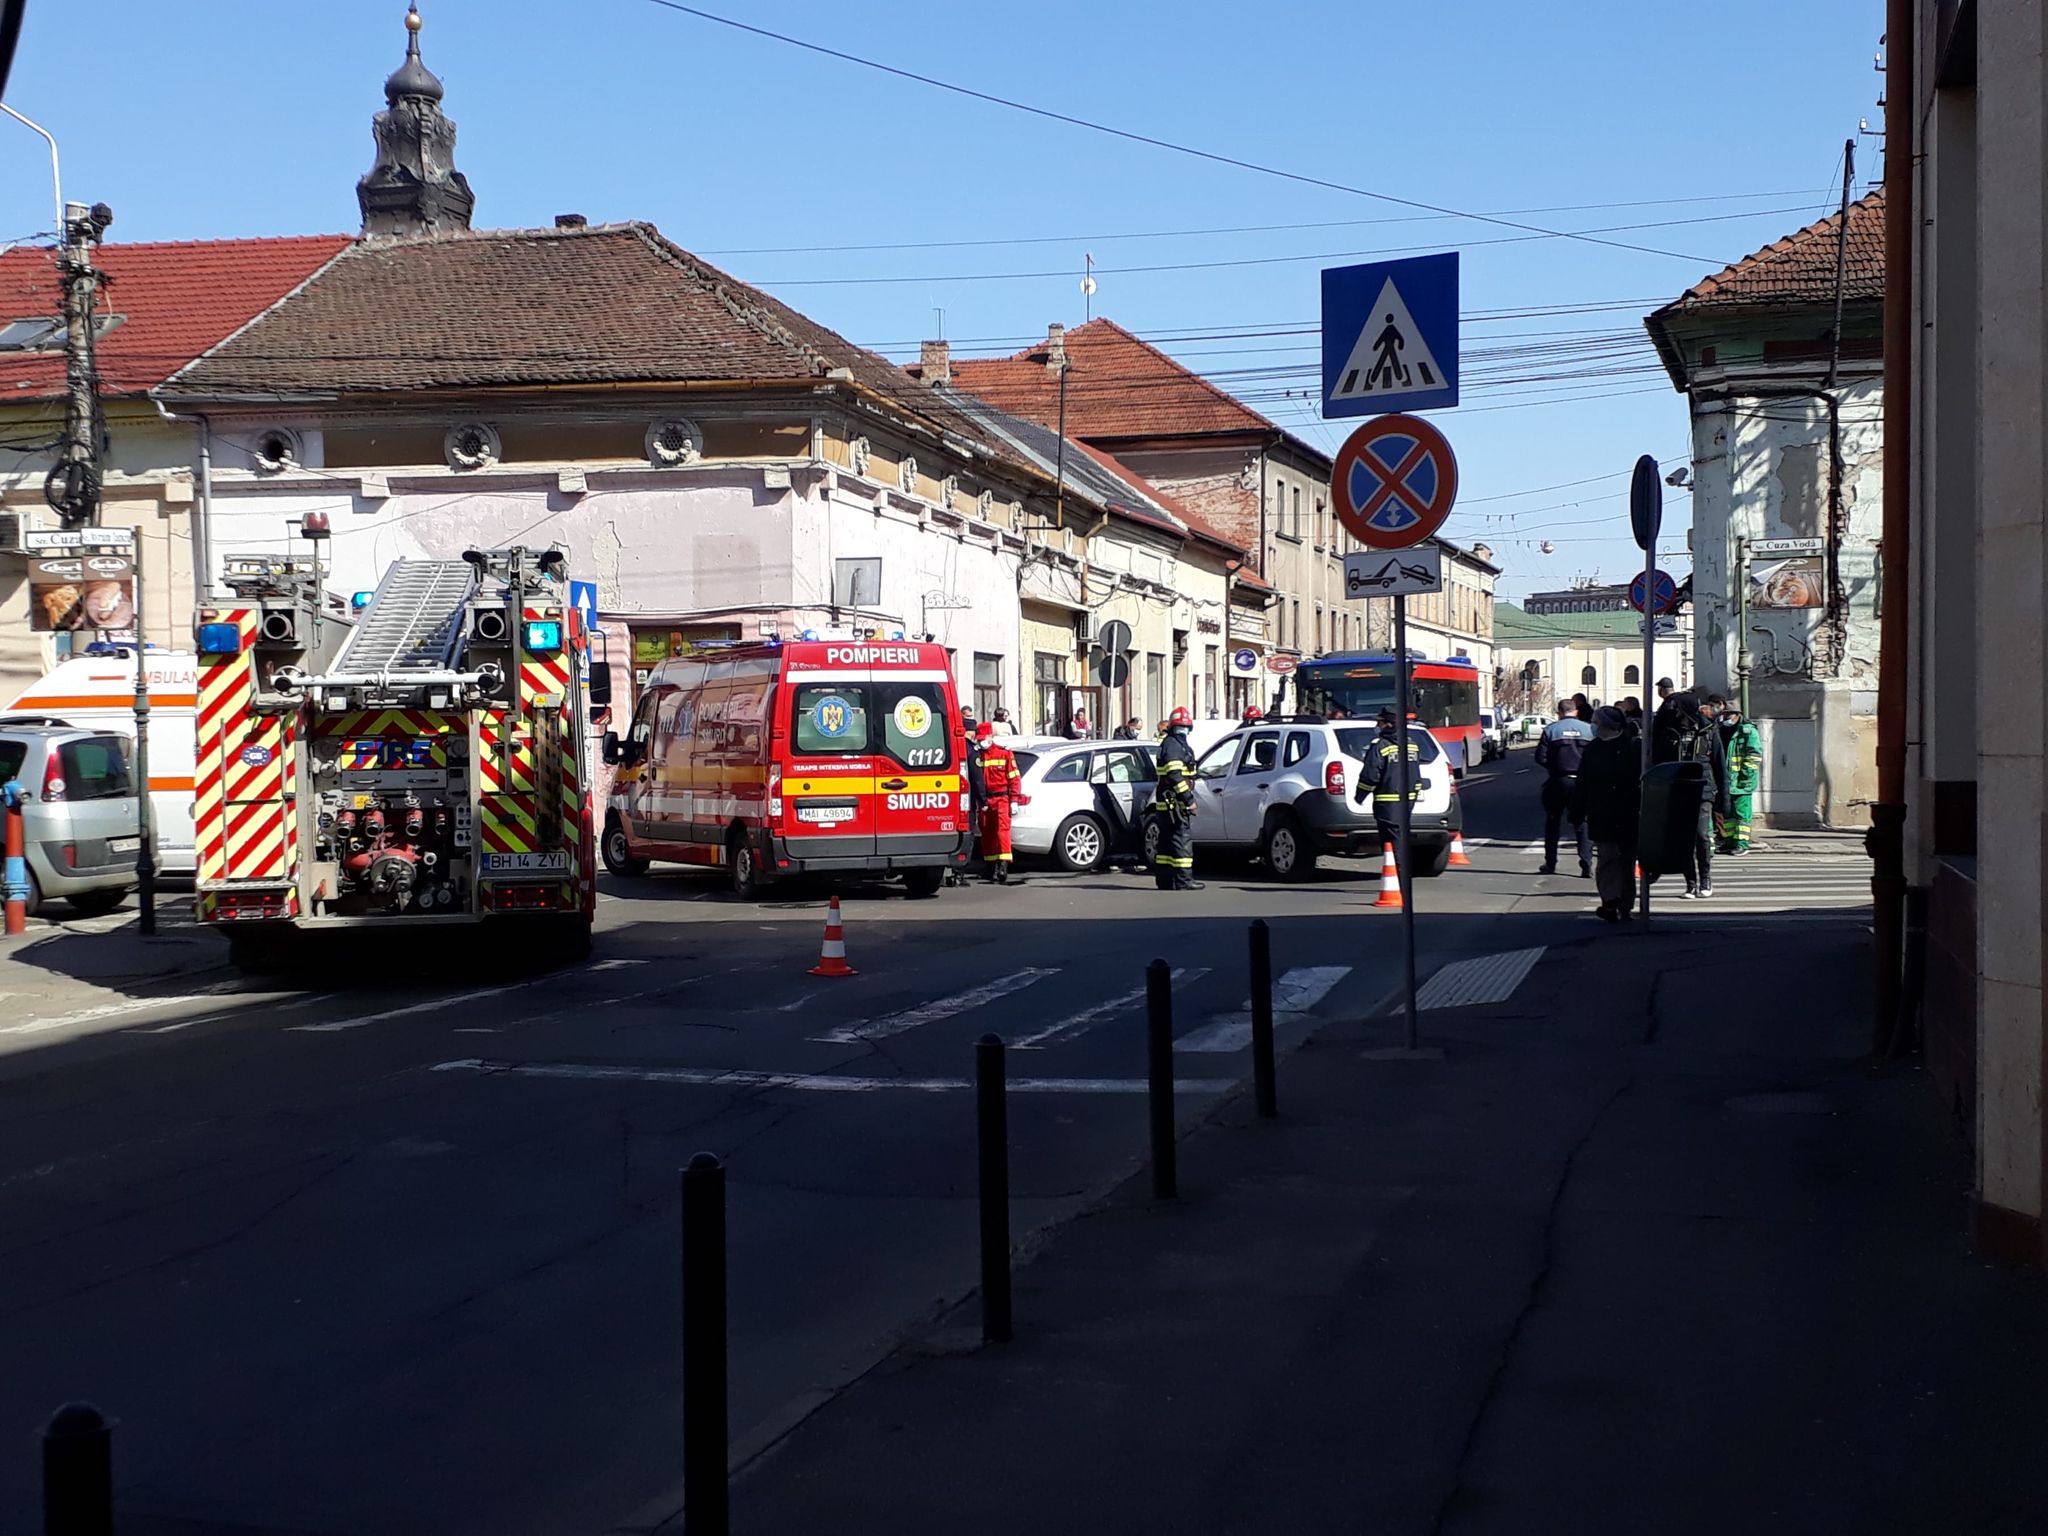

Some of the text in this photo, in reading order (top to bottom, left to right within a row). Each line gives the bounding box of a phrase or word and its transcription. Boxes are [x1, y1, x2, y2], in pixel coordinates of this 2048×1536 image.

[1766, 541, 1790, 550] Cuza
[827, 648, 920, 664] POMPIERII
[355, 740, 432, 765] FIRE
[916, 749, 945, 766] 112
[887, 793, 950, 810] SMURD
[823, 808, 851, 818] 49694
[491, 855, 512, 868] BH
[517, 854, 530, 868] 14
